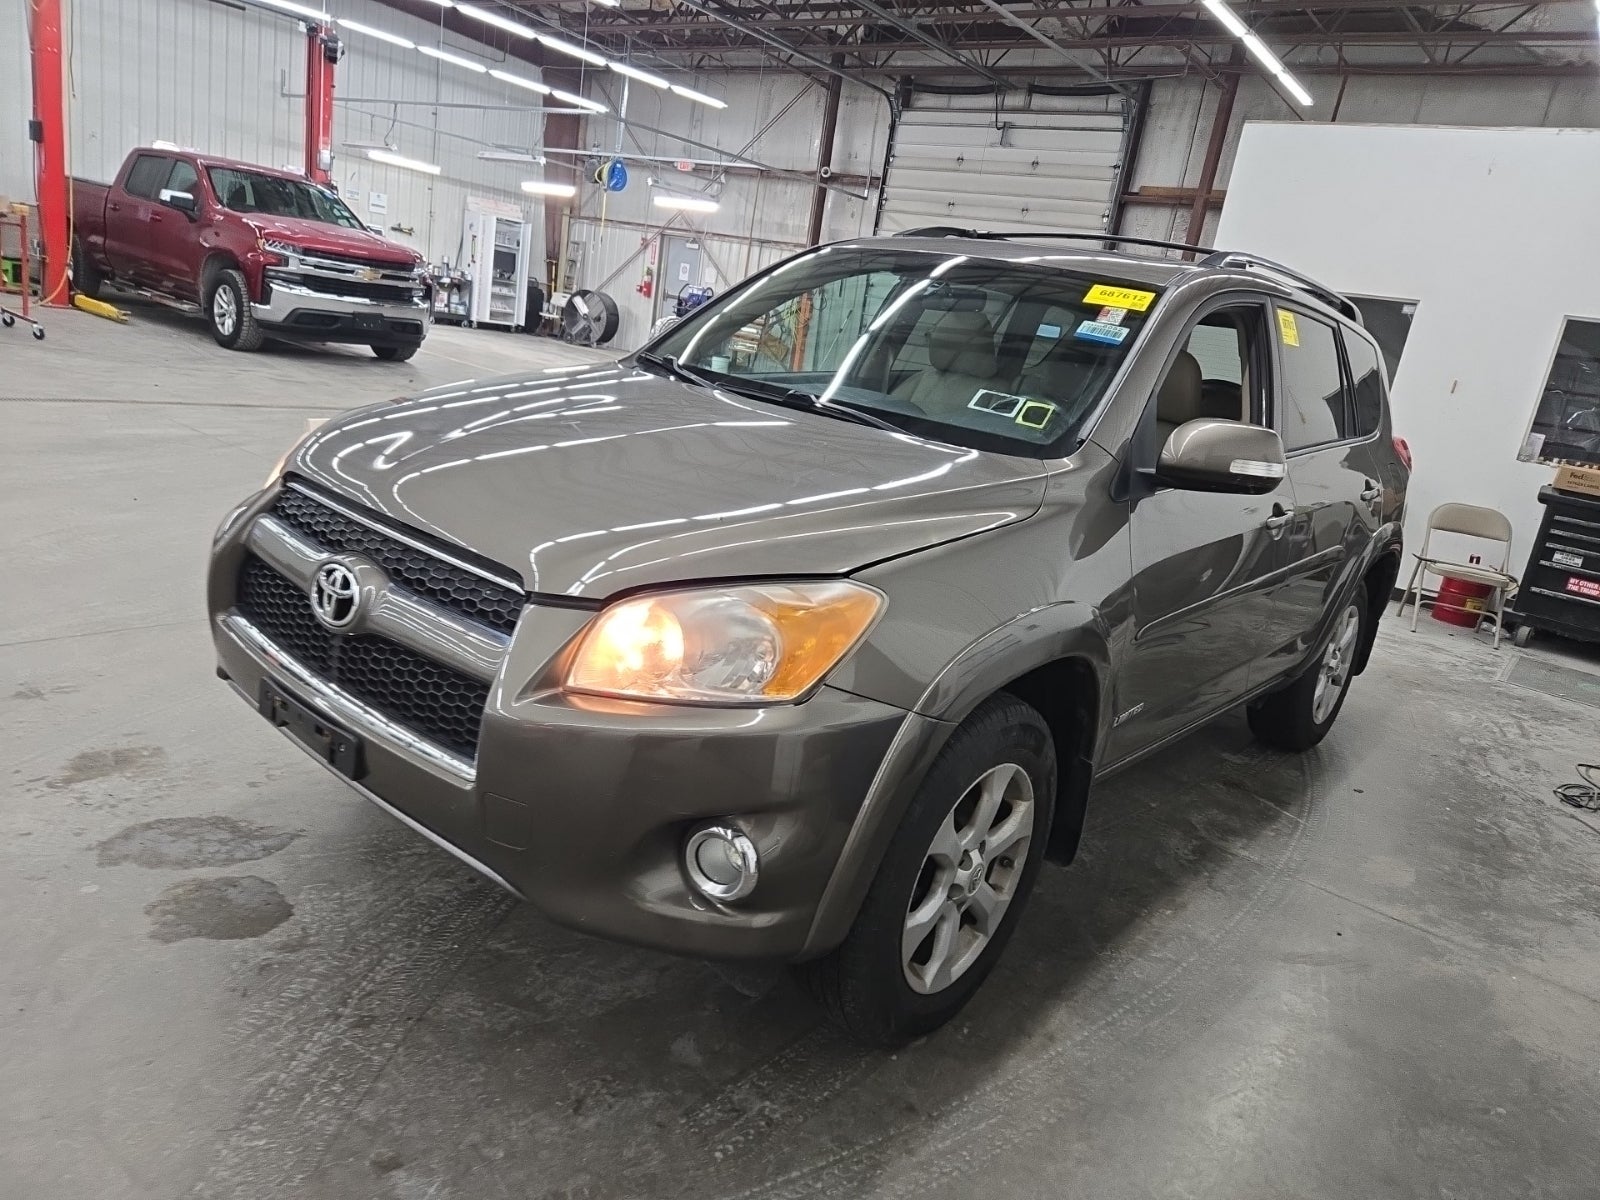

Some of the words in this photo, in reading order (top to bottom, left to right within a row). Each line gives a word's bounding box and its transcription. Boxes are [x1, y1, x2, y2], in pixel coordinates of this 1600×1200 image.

[1099, 290, 1147, 301] 687612
[1567, 583, 1580, 591] THE
[1580, 580, 1599, 589] OTHER
